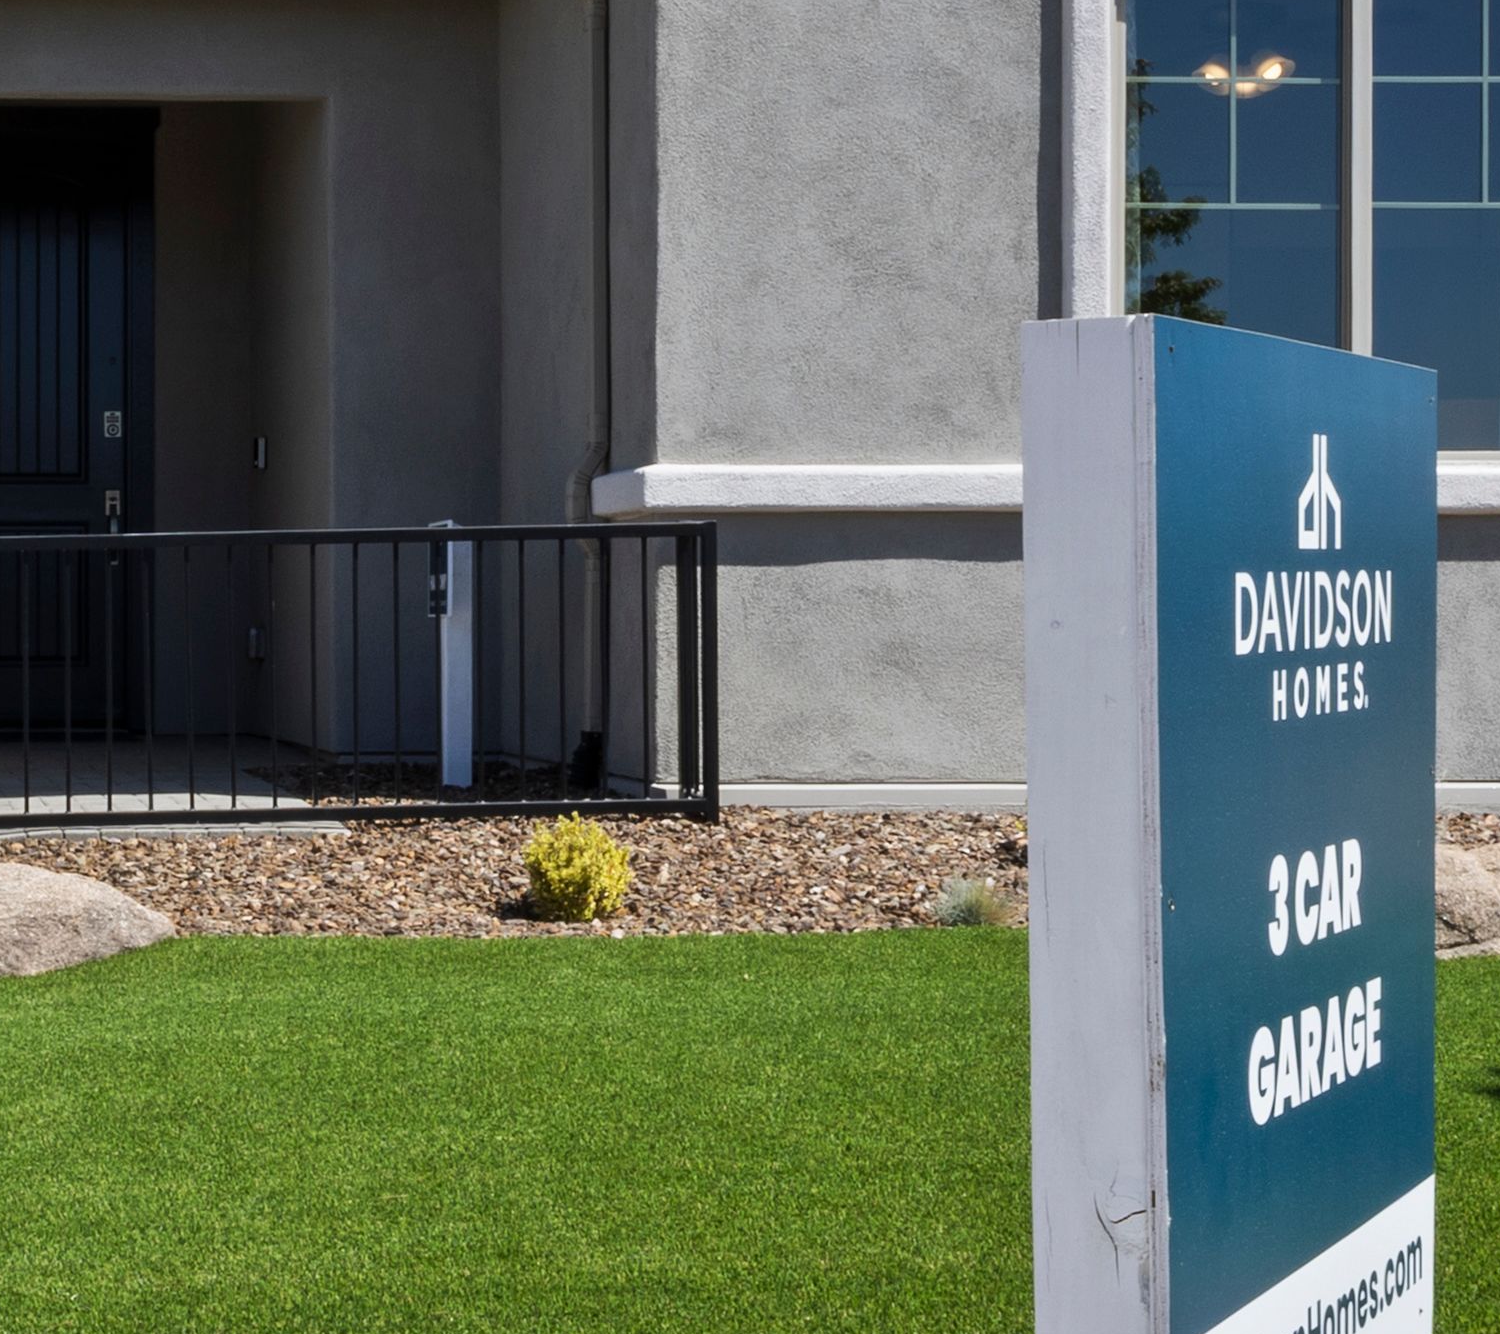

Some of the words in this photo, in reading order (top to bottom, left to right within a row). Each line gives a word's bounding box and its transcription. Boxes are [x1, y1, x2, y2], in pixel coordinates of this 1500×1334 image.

[1234, 569, 1393, 656] DAVIDSON
[1268, 853, 1290, 957] 3
[1294, 837, 1363, 946] CAR
[1248, 975, 1382, 1126] GARAGE
